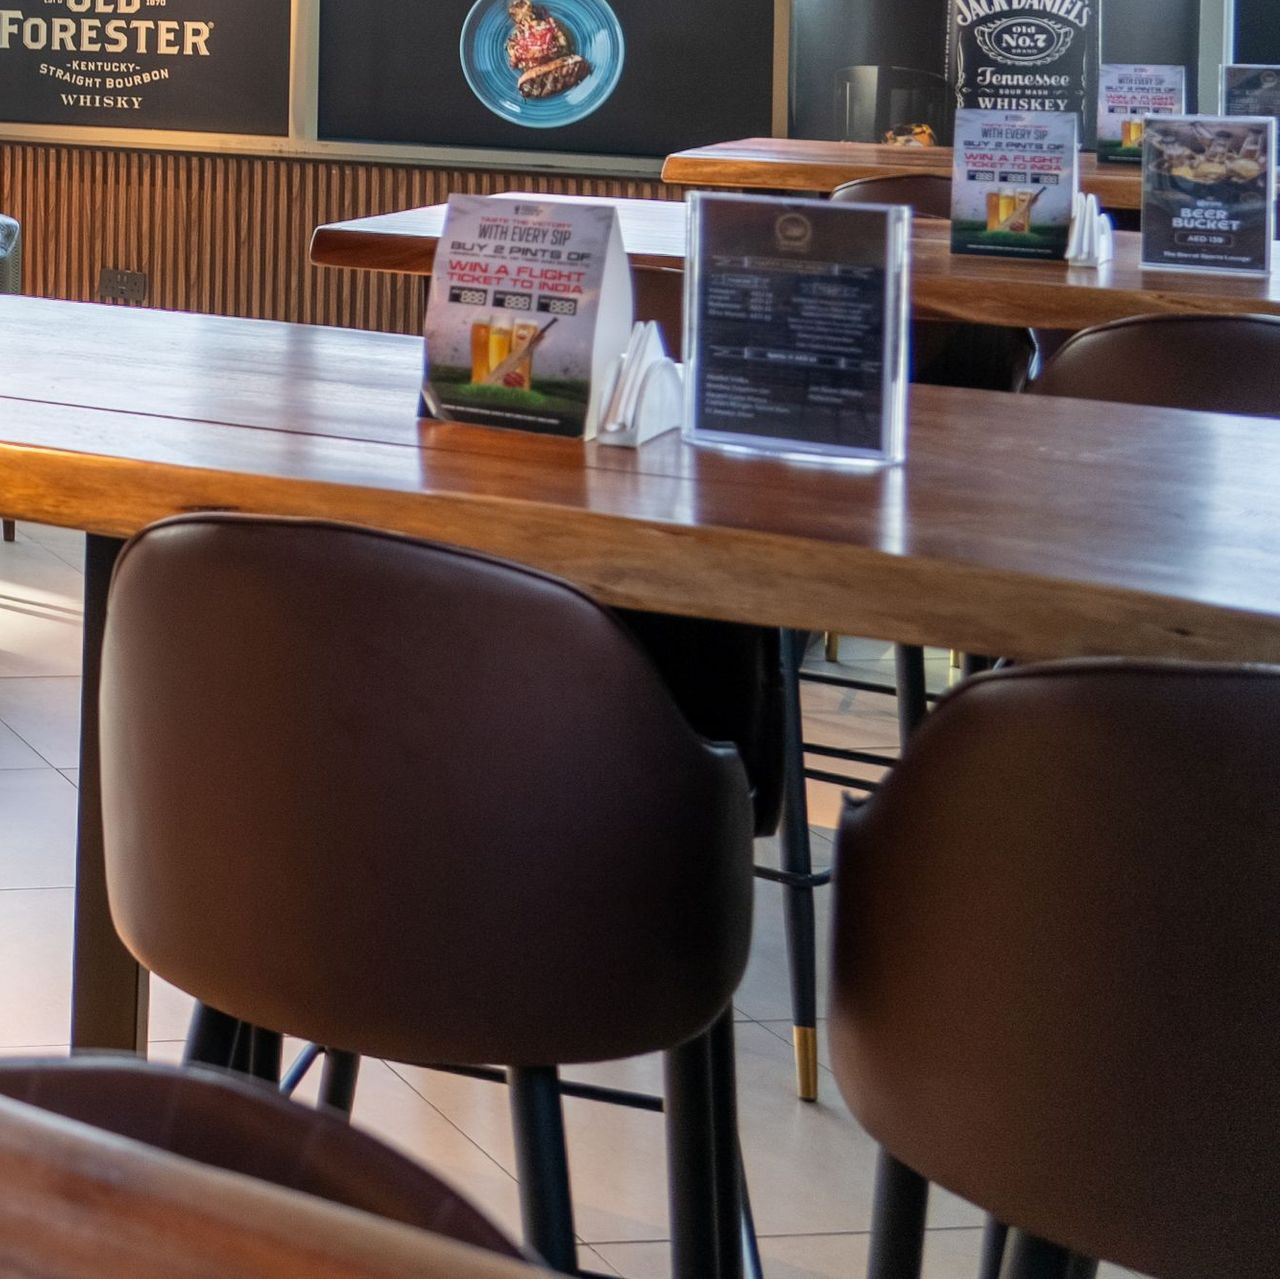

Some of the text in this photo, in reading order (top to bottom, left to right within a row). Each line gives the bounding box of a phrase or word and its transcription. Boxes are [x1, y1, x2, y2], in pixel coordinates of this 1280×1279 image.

[0, 9, 211, 56] FORESTER
[1012, 25, 1036, 33] Old
[1002, 34, 1047, 48] No.7
[39, 64, 169, 89] STRAIGHT BOURBON
[977, 67, 1070, 86] Tennessee
[60, 93, 143, 109] WHISKY
[977, 97, 1068, 110] WHISKEY
[981, 127, 1048, 140] WITH EVERY SIP
[964, 153, 992, 161] WIN
[1014, 155, 1062, 163] FLIGHT
[1181, 208, 1228, 219] BEER
[1172, 217, 1240, 231] BUCKET
[478, 223, 572, 246] WITH EVERY SIP
[451, 241, 487, 251] BUY
[493, 246, 505, 254] 2
[509, 246, 561, 259] PINTS
[567, 251, 592, 261] OF
[448, 260, 585, 281] WIN A FLIGHT
[447, 272, 584, 294] TICKET TO INDIA
